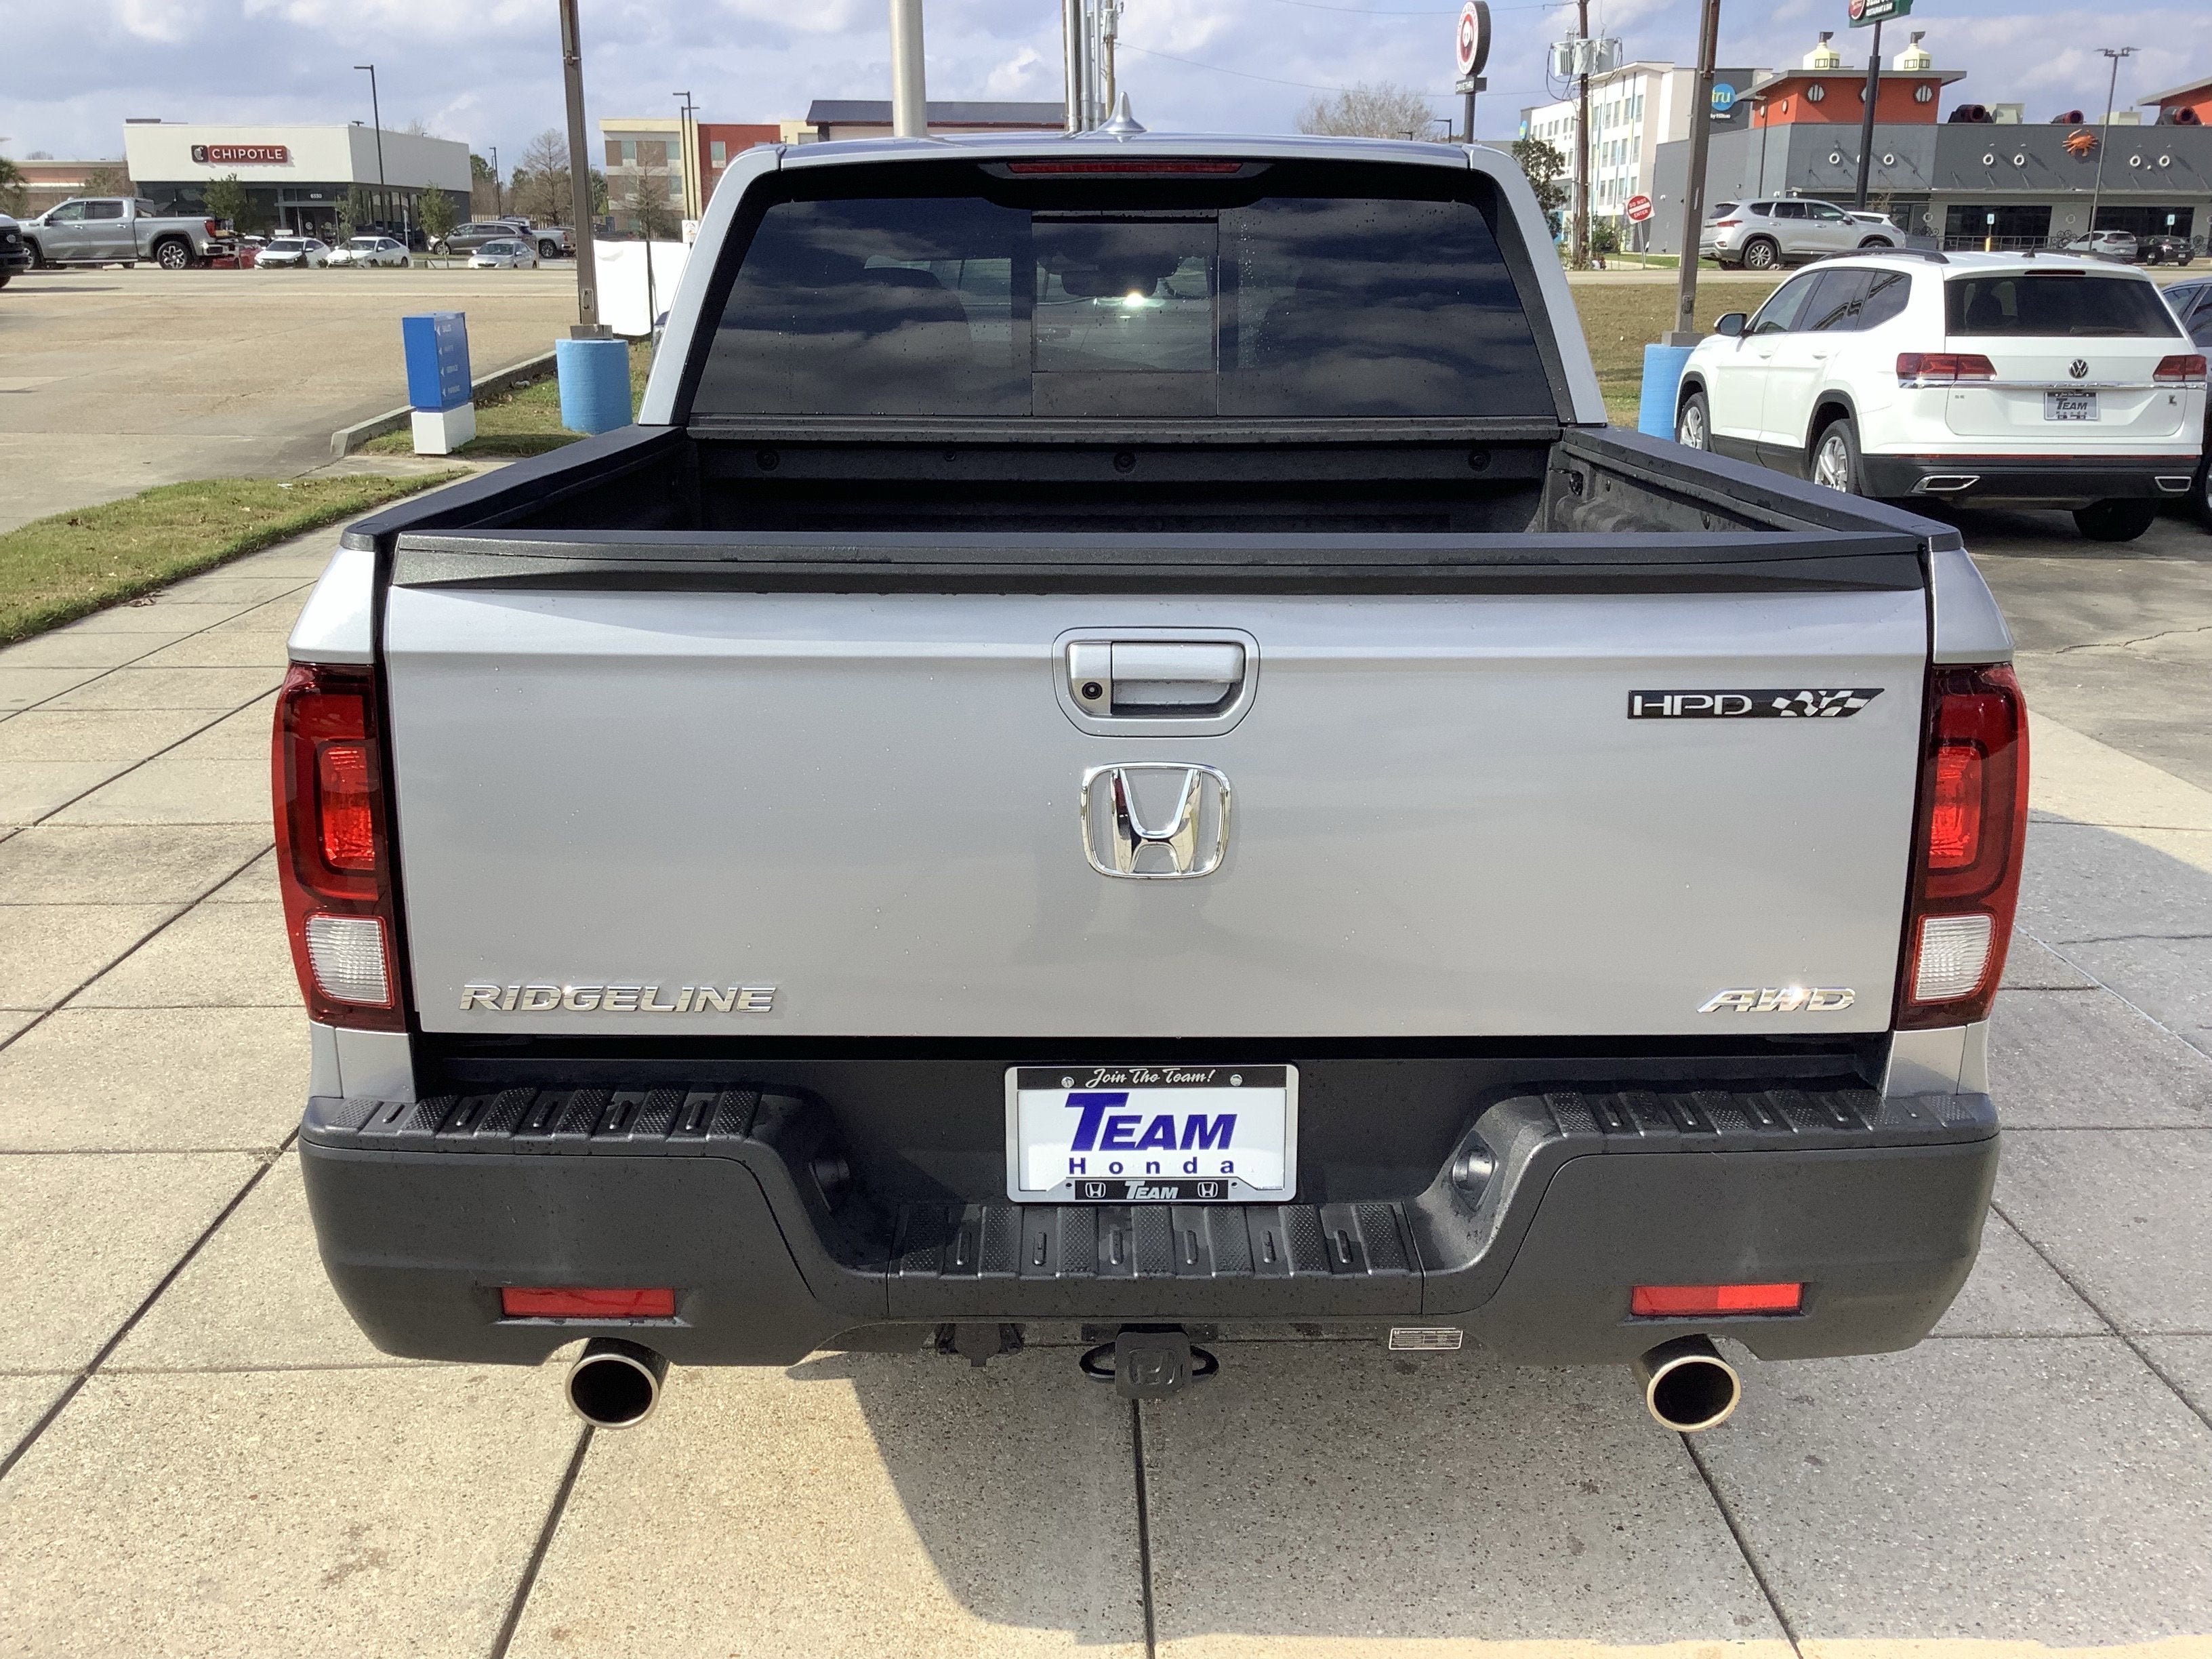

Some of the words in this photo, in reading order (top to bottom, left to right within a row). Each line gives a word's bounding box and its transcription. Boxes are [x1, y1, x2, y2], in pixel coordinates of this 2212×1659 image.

[211, 148, 283, 159] CHIPOTLE
[2055, 398, 2088, 410] TEAM
[1633, 694, 1753, 716] HPD
[459, 983, 777, 1012] RIDGELINE
[1696, 986, 1856, 1013] AWD
[1085, 1067, 1127, 1088] Join
[1128, 1067, 1161, 1084] The
[1162, 1067, 1216, 1084] Team!
[1065, 1092, 1237, 1151] TEAM
[1069, 1156, 1234, 1174] Honda
[1124, 1181, 1179, 1200] TEAM
